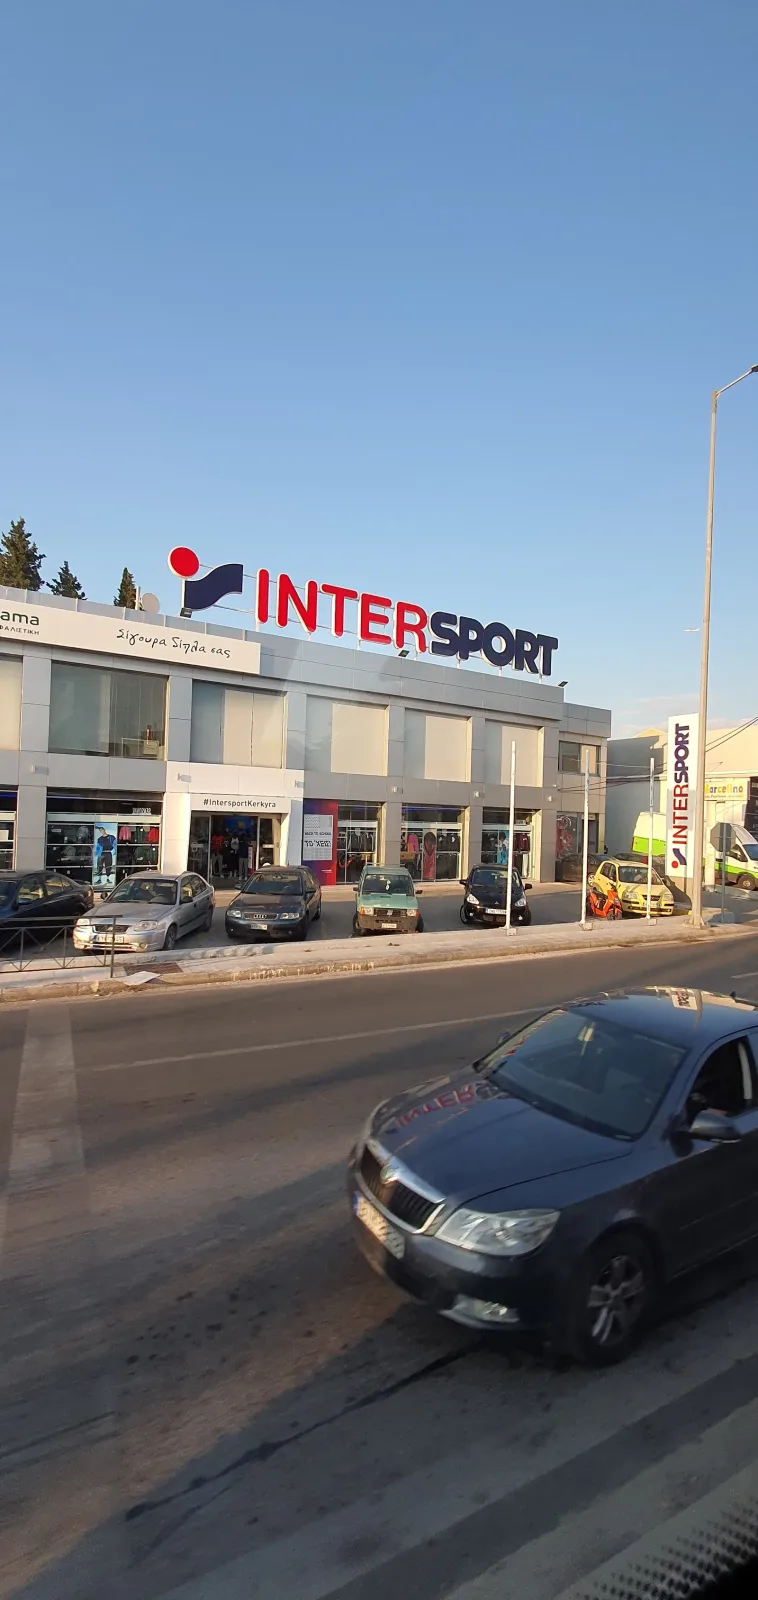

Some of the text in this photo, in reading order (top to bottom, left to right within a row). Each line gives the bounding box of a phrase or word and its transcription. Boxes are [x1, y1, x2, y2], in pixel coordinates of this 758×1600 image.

[116, 628, 167, 649] Σίγουρα
[254, 568, 559, 677] INTERSPORT
[203, 798, 277, 809] #IntersportKerkyra
[672, 723, 690, 845] INTERSPORT
